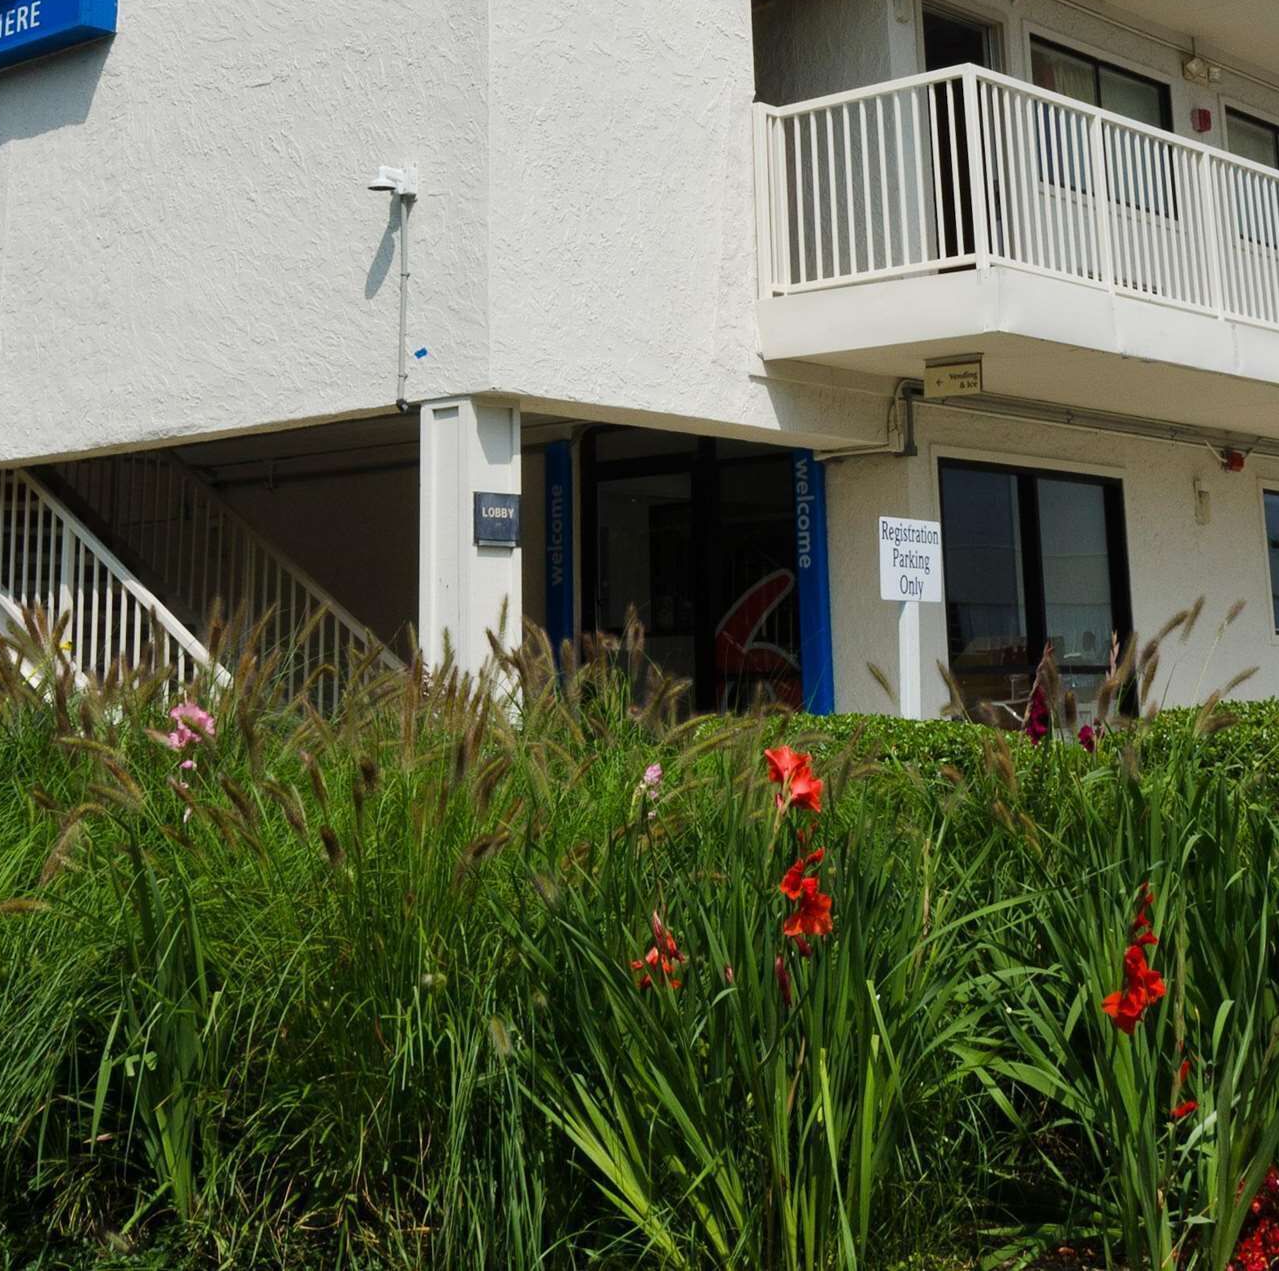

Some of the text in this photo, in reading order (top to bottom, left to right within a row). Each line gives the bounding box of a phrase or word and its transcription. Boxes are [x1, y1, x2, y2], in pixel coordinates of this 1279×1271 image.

[482, 506, 514, 519] LOBBY
[795, 458, 815, 568] welcome
[548, 484, 563, 587] welcome
[881, 521, 939, 547] Registration
[892, 548, 930, 575] Parking
[900, 574, 924, 600] Only
